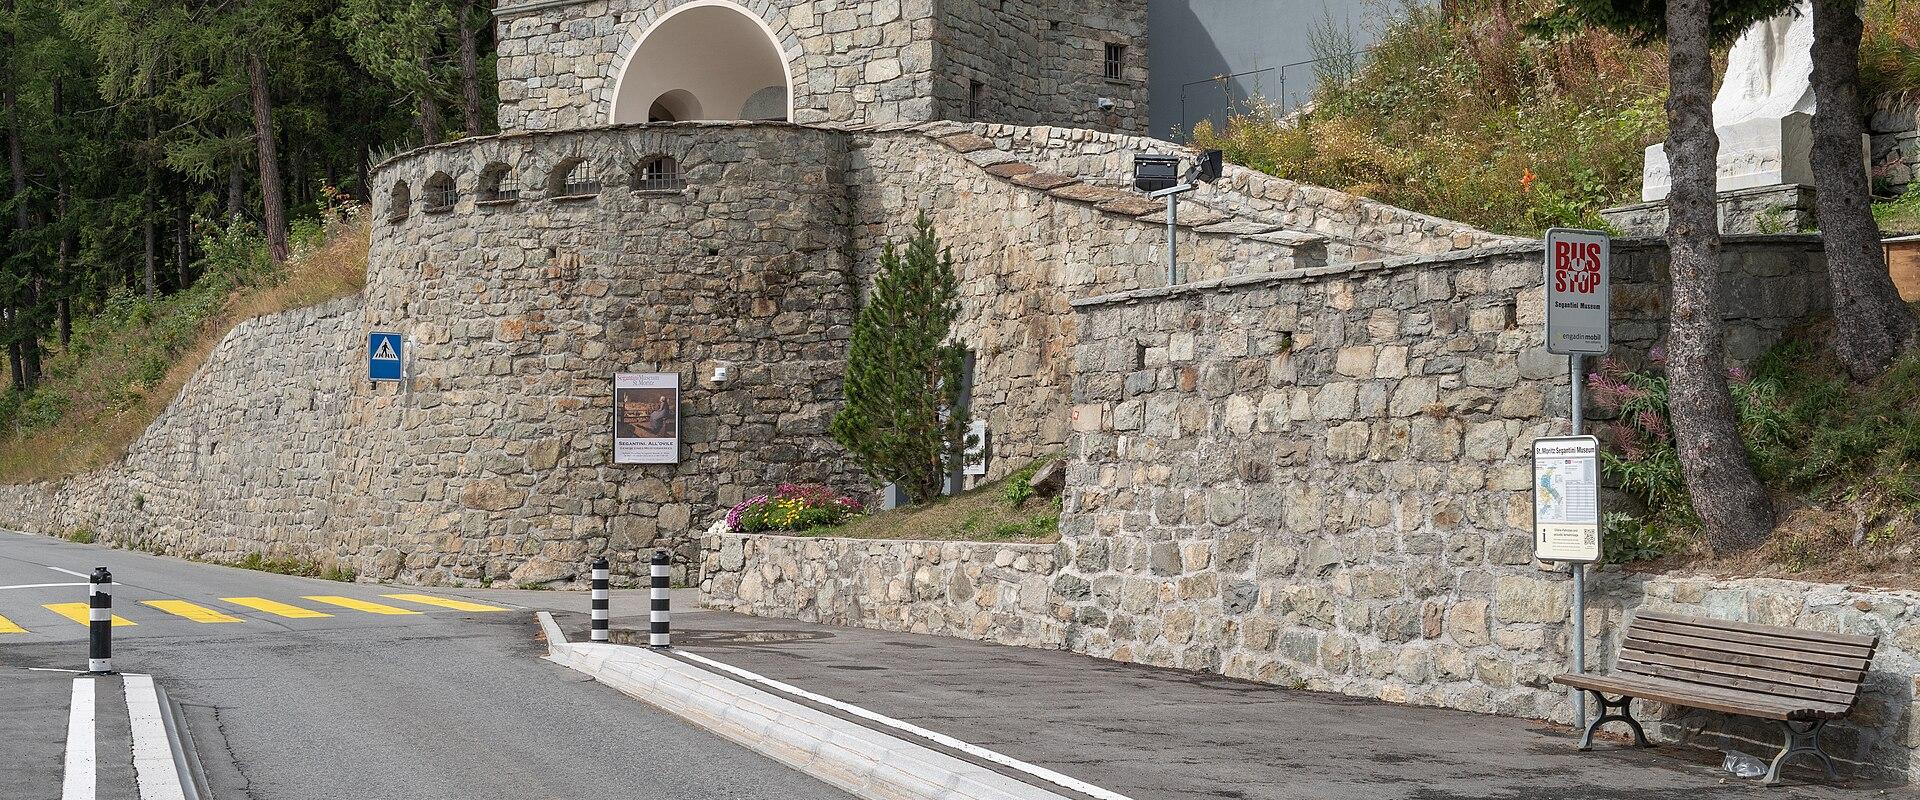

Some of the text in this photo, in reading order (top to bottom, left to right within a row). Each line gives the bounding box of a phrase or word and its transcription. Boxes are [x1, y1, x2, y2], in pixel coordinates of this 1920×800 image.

[1556, 241, 1601, 272] BUS
[1555, 270, 1601, 293] STOP
[1555, 301, 1600, 310] Segantini Museum
[1555, 446, 1576, 455] Segantini
